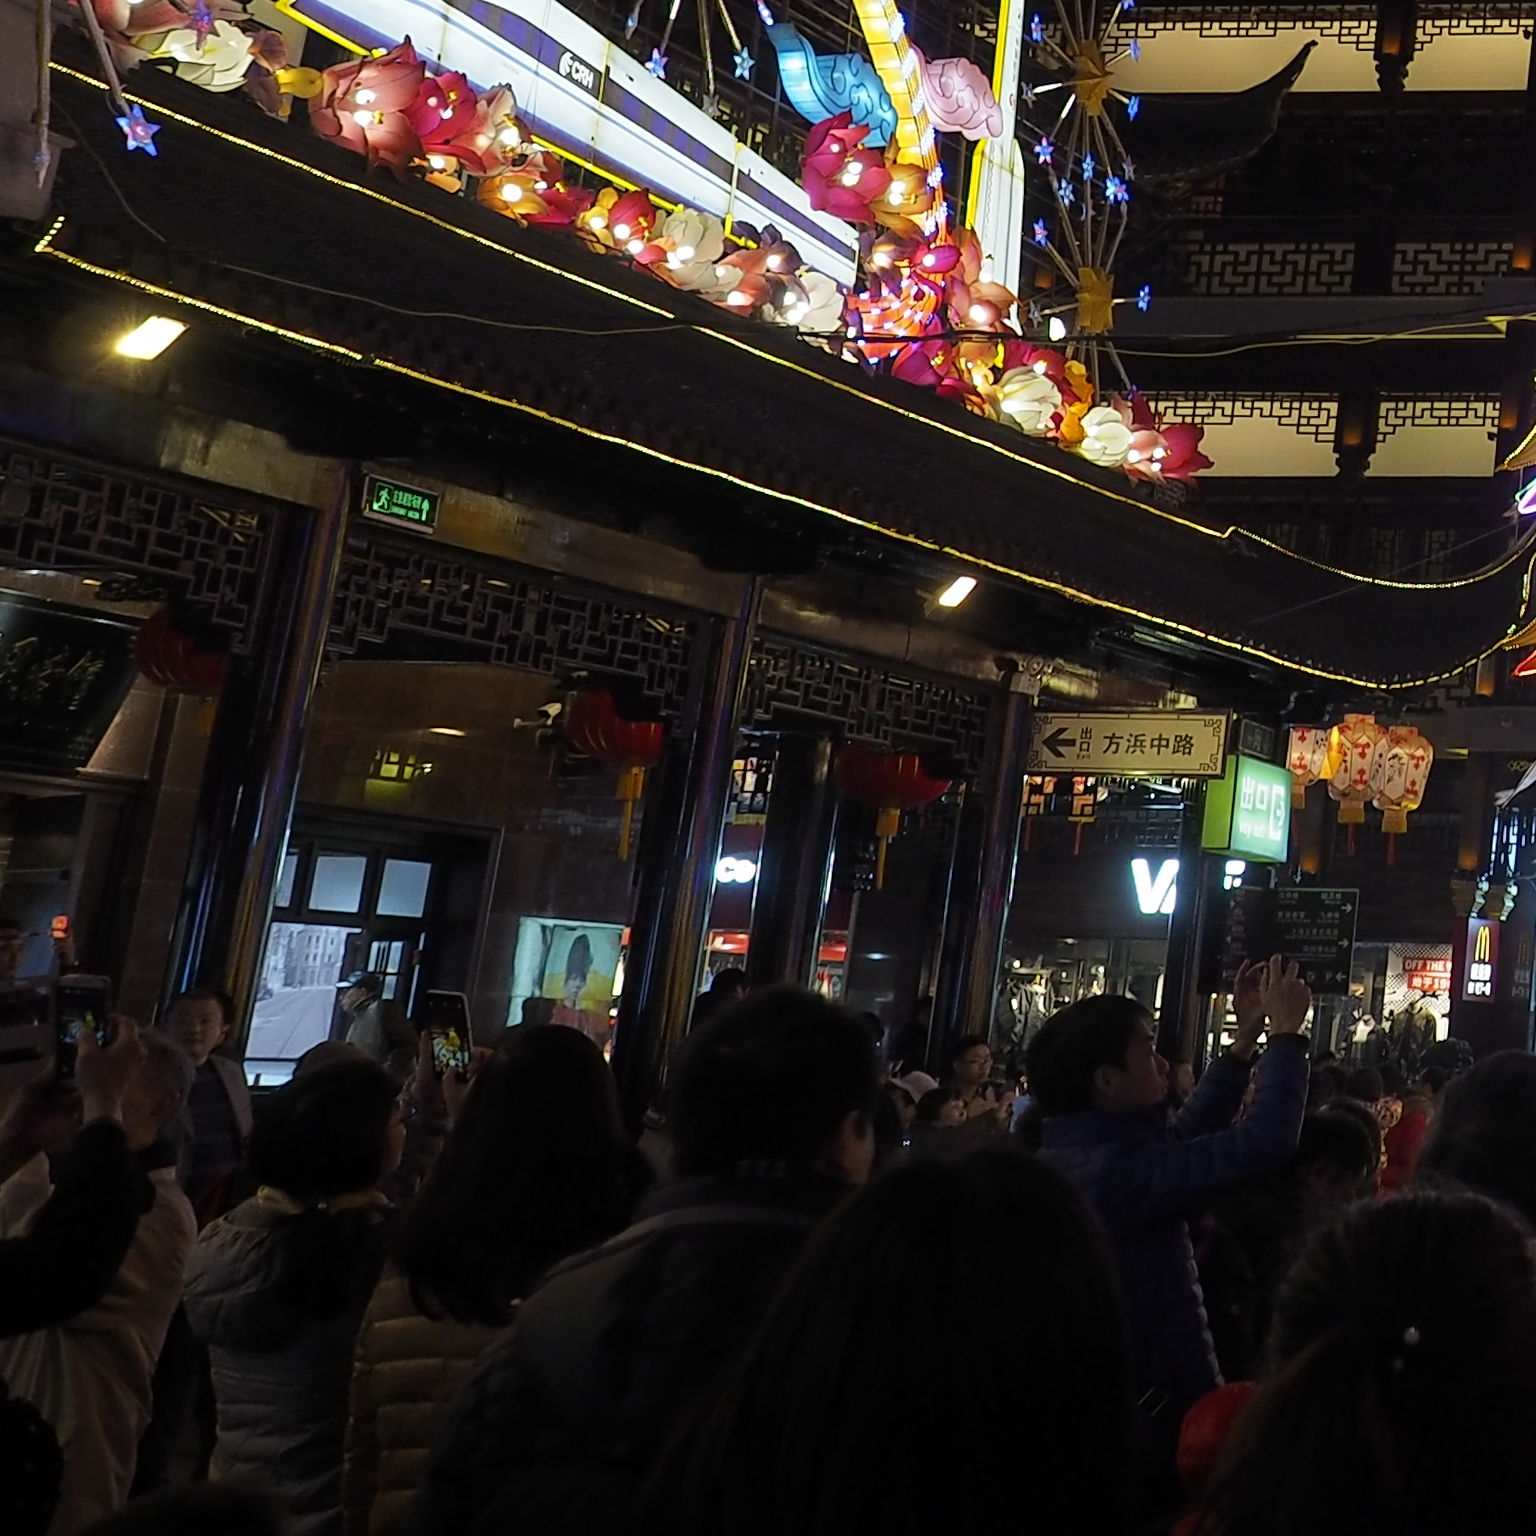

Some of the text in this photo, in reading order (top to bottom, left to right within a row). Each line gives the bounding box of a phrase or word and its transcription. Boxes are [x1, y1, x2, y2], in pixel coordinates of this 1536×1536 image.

[1079, 726, 1093, 753] 出口
[1102, 732, 1195, 756] 方浜中路
[1240, 776, 1269, 812] 出口
[1404, 959, 1424, 971] OFF
[1426, 960, 1445, 972] THE
[1411, 976, 1451, 990] 始于19
